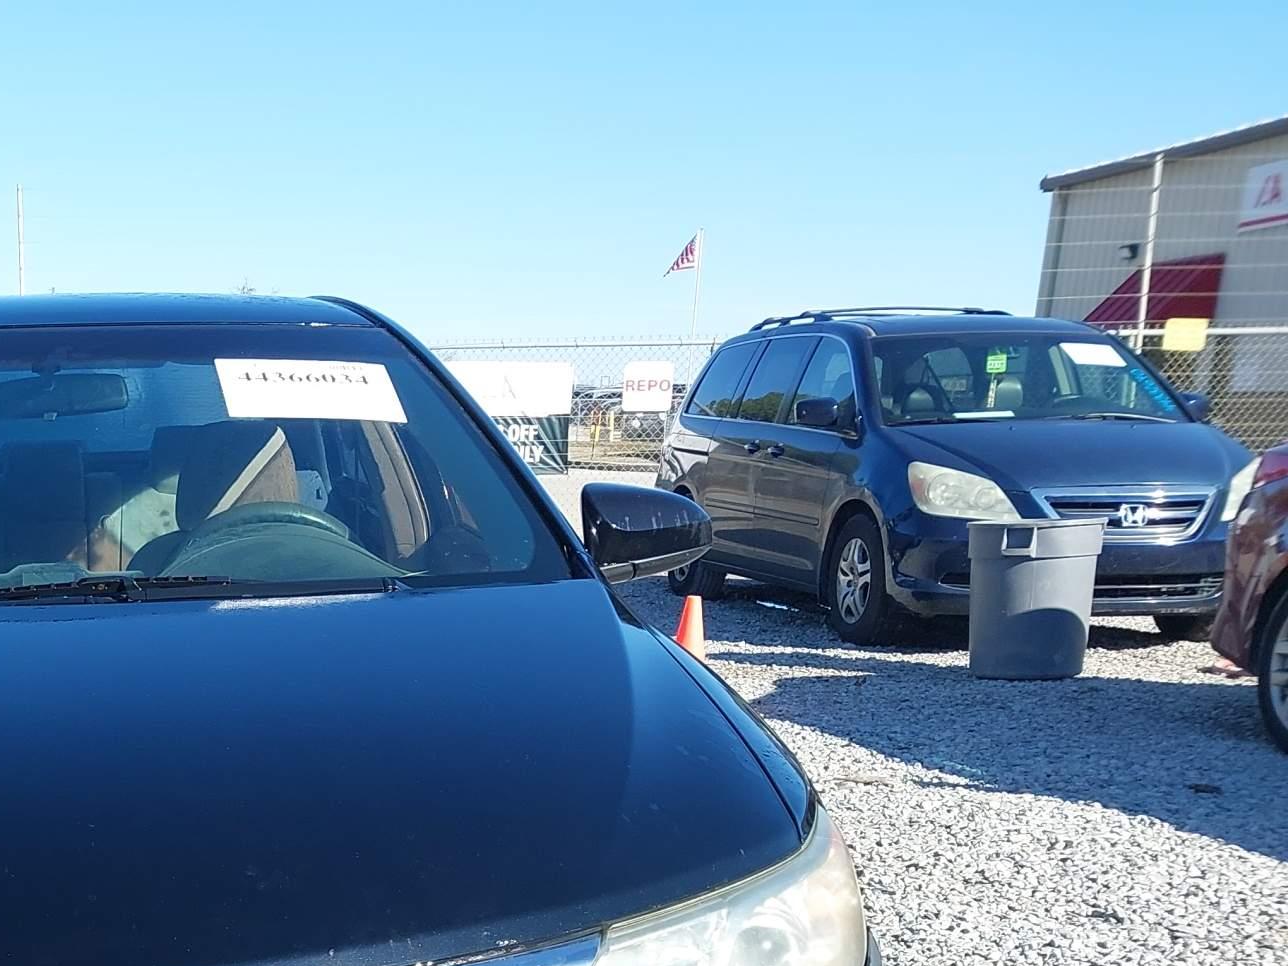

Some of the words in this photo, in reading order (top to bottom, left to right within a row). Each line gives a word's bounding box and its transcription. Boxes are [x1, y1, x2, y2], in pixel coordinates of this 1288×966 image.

[237, 371, 369, 385] 44366034
[624, 379, 671, 392] REPO
[513, 445, 544, 464] NLY
